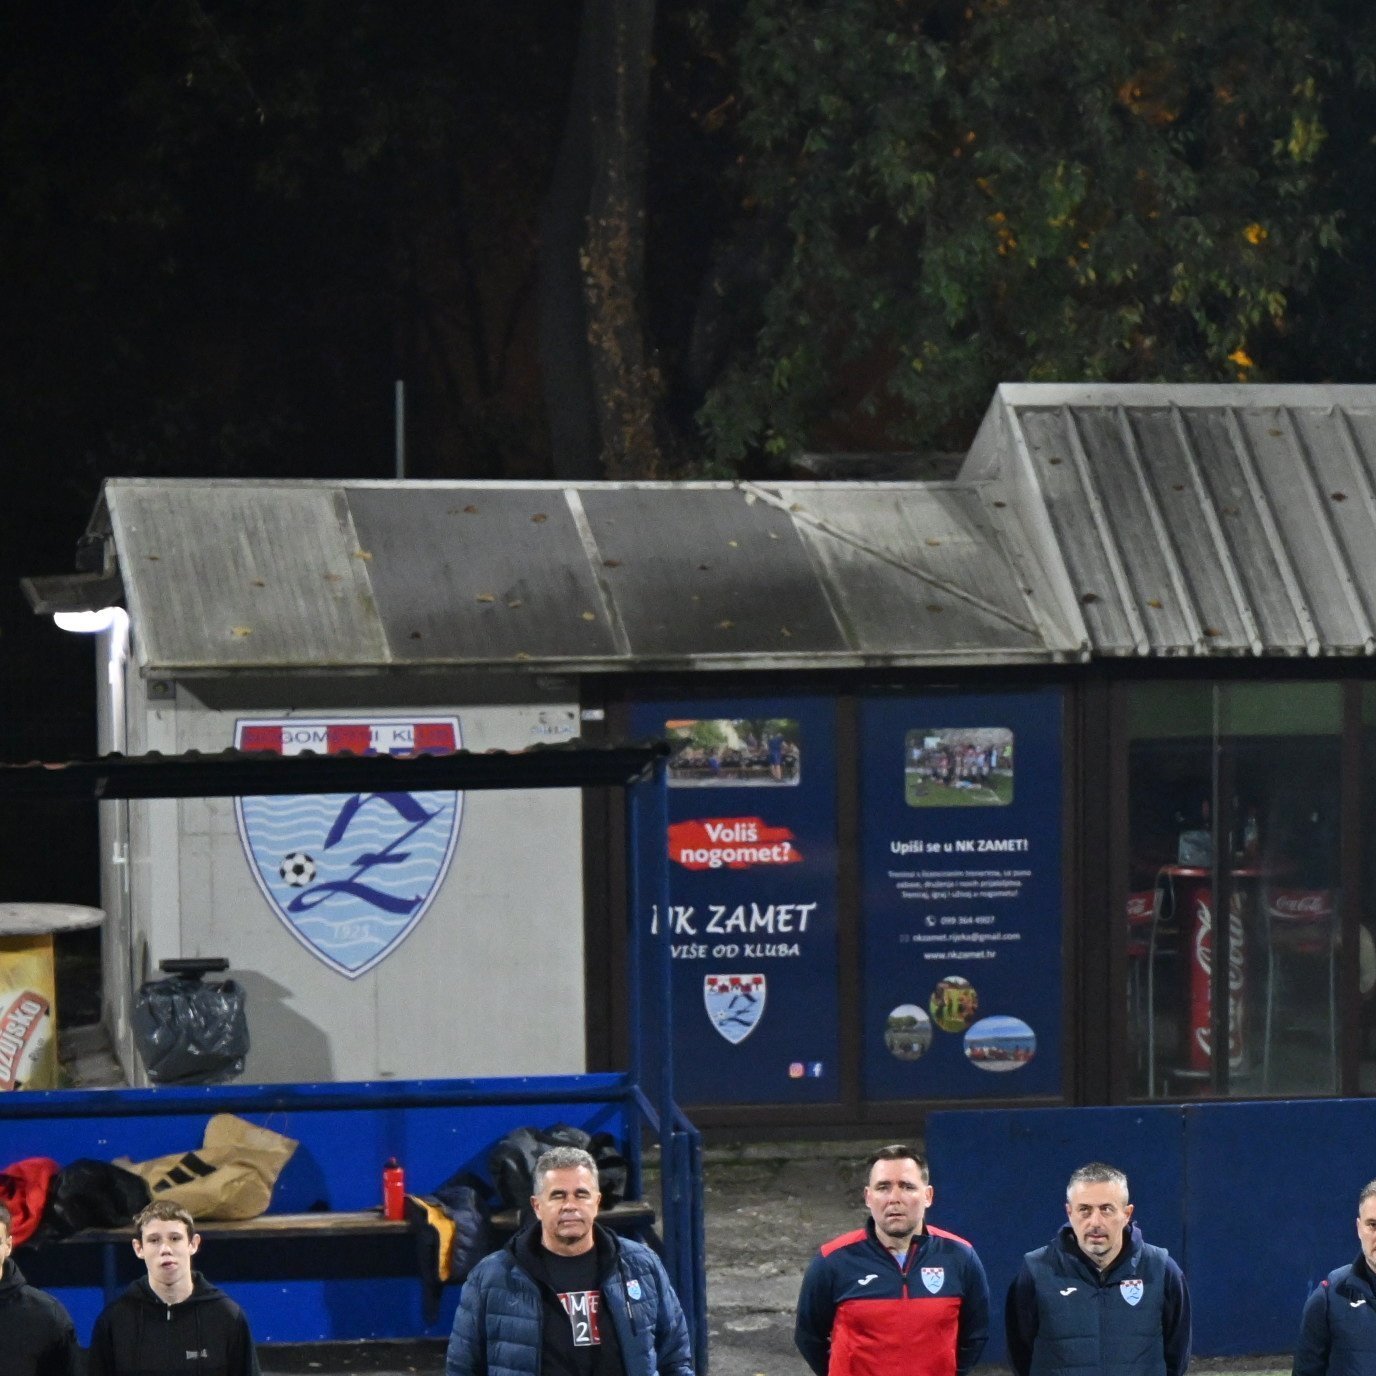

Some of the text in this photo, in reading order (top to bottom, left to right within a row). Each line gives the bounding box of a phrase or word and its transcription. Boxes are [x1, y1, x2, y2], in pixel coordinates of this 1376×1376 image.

[704, 822, 758, 842] Voliš
[680, 842, 791, 868] nogomet?
[890, 838, 1028, 855] Upiši se u NK ZAMET!
[706, 902, 817, 934] ZAMET
[670, 943, 800, 959] VIŠE OD KLUBA
